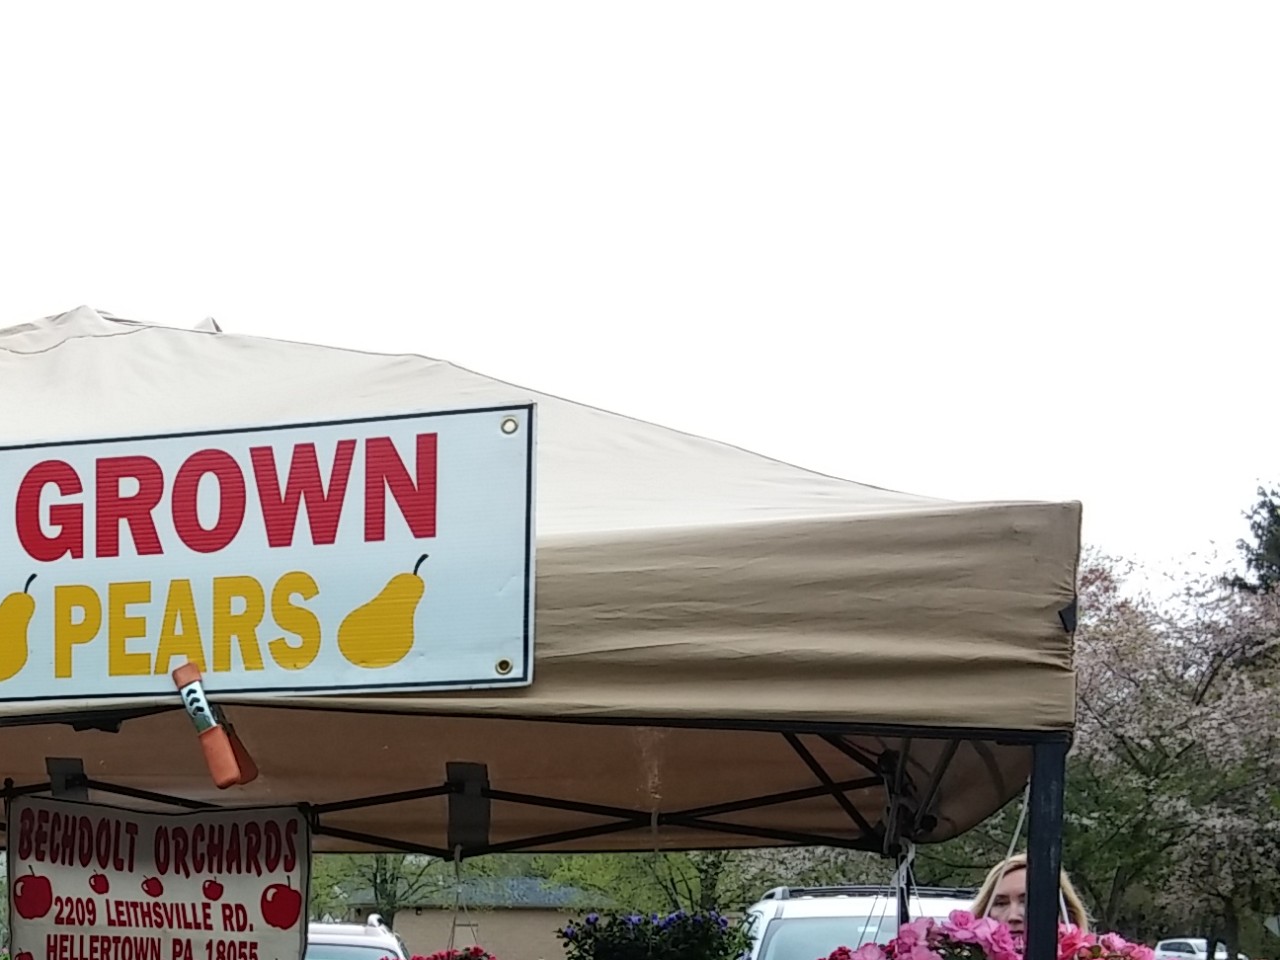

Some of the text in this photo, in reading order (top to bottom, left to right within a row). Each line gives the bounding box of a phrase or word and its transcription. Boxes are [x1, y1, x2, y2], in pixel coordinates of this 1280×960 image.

[15, 433, 438, 562] GROWN
[54, 570, 321, 679] PEARS
[18, 807, 298, 878] BECHDOLT ORCHARDS
[54, 896, 254, 932] 2209 LEITHSVILLE RD.
